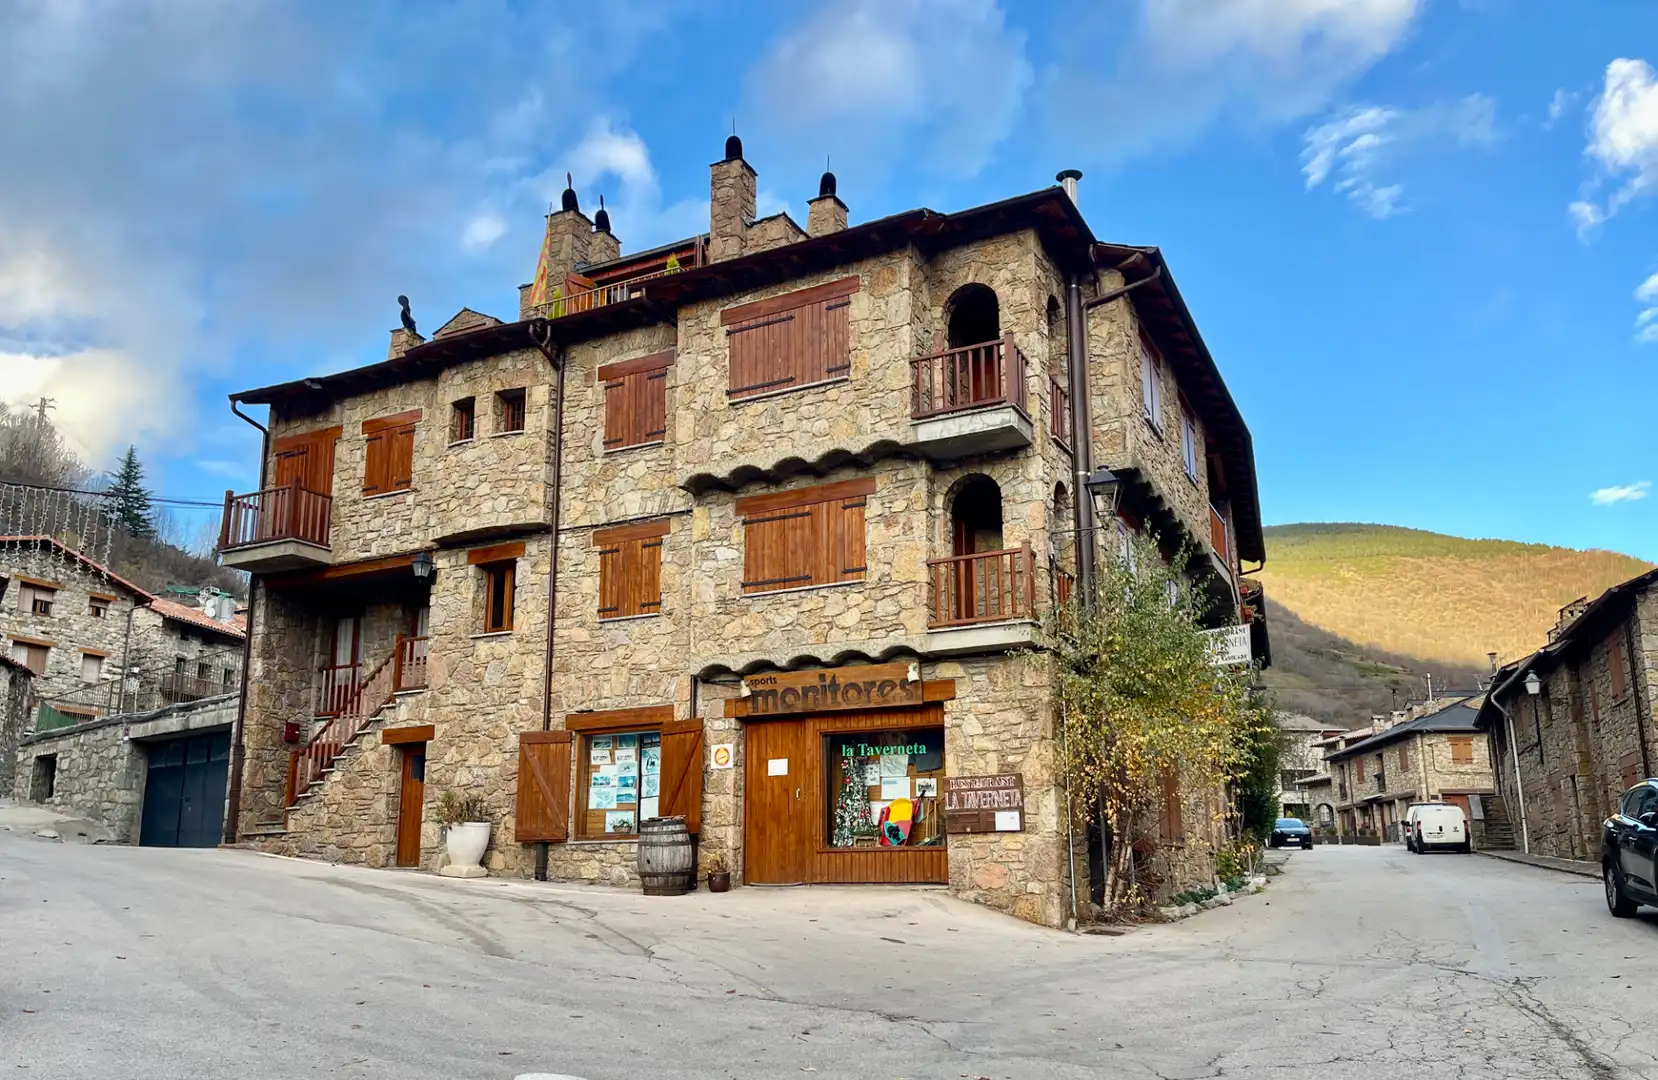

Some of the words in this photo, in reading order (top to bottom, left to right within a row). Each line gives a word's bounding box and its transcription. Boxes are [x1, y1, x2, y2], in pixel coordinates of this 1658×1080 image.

[750, 676, 777, 689] sports
[752, 673, 914, 713] monitores
[842, 744, 854, 757] la
[858, 743, 927, 757] Taverneta
[949, 776, 1016, 790] RESTAURANT
[944, 791, 960, 810] LA
[961, 789, 1023, 809] TAVERNETA
